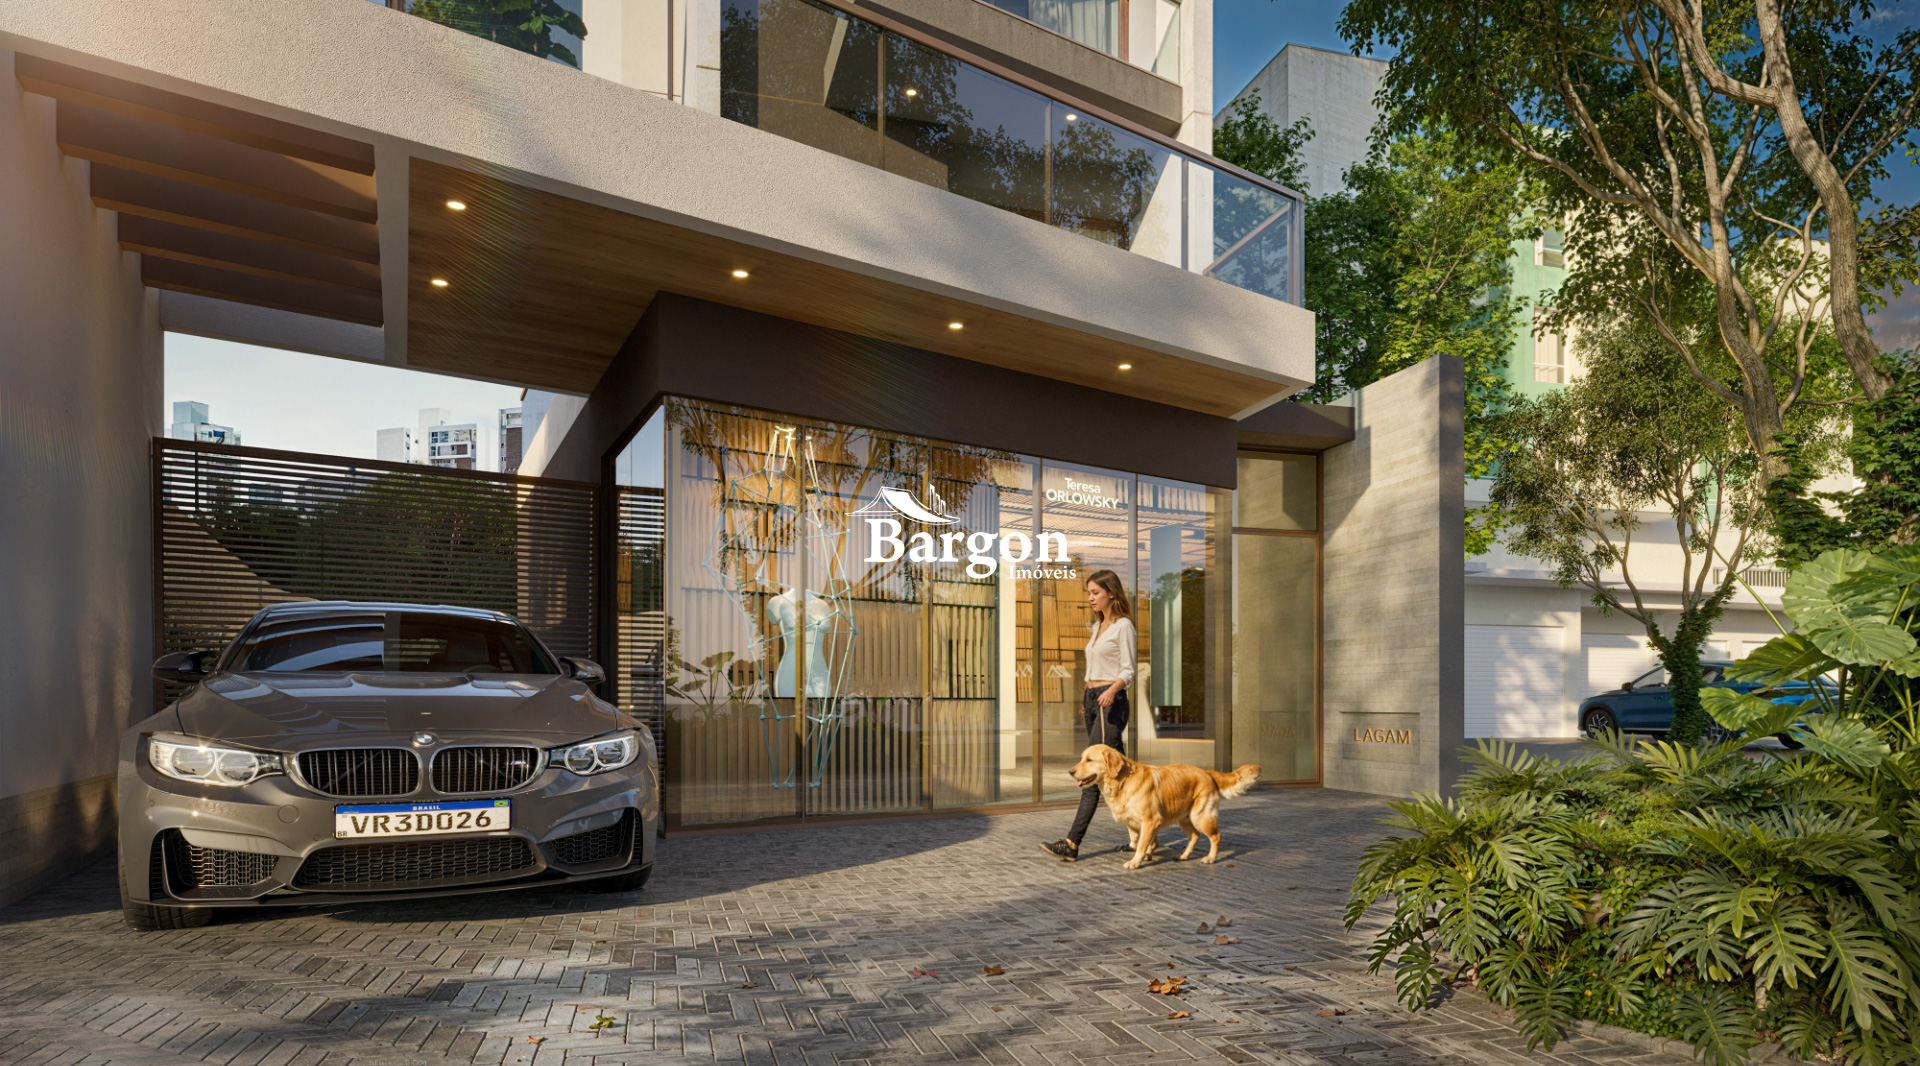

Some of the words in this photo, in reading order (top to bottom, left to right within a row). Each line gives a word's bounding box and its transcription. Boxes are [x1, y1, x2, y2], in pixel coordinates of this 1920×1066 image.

[1064, 477, 1101, 494] Teresa
[1045, 488, 1120, 510] ORLOWSKY
[1354, 727, 1412, 745] LAGAM
[412, 804, 441, 812] BRASIL
